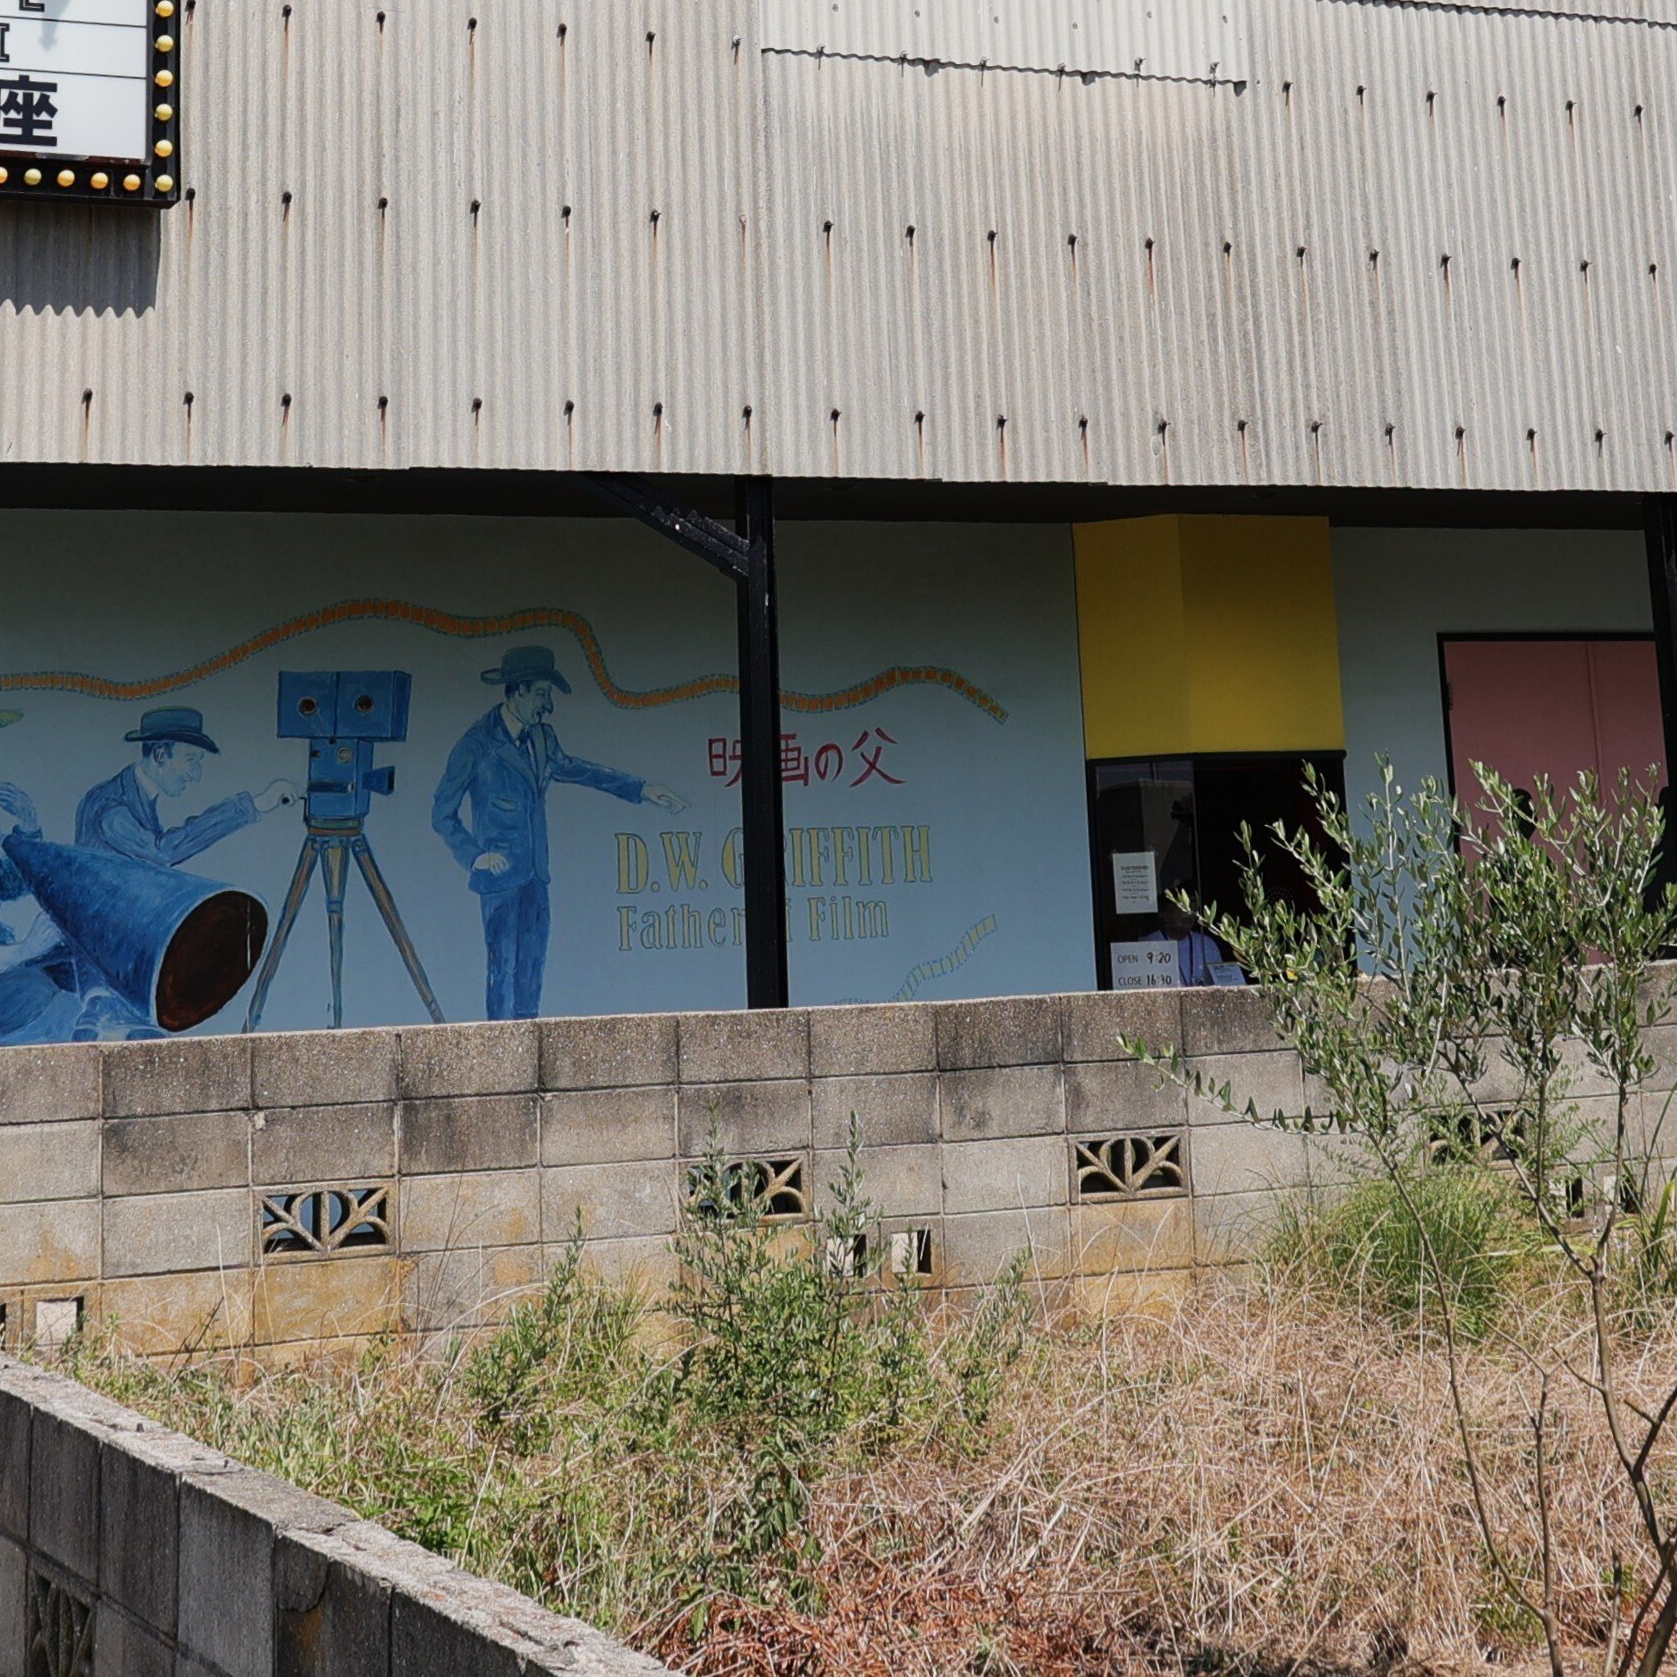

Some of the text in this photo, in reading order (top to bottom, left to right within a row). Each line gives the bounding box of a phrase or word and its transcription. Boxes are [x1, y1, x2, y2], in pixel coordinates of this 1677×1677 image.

[614, 825, 933, 894] D.W. GIFFITH
[616, 903, 747, 951] Father
[808, 896, 890, 942] Film
[1117, 951, 1172, 965] OPEN 9:20
[1118, 976, 1142, 986] CLOSE
